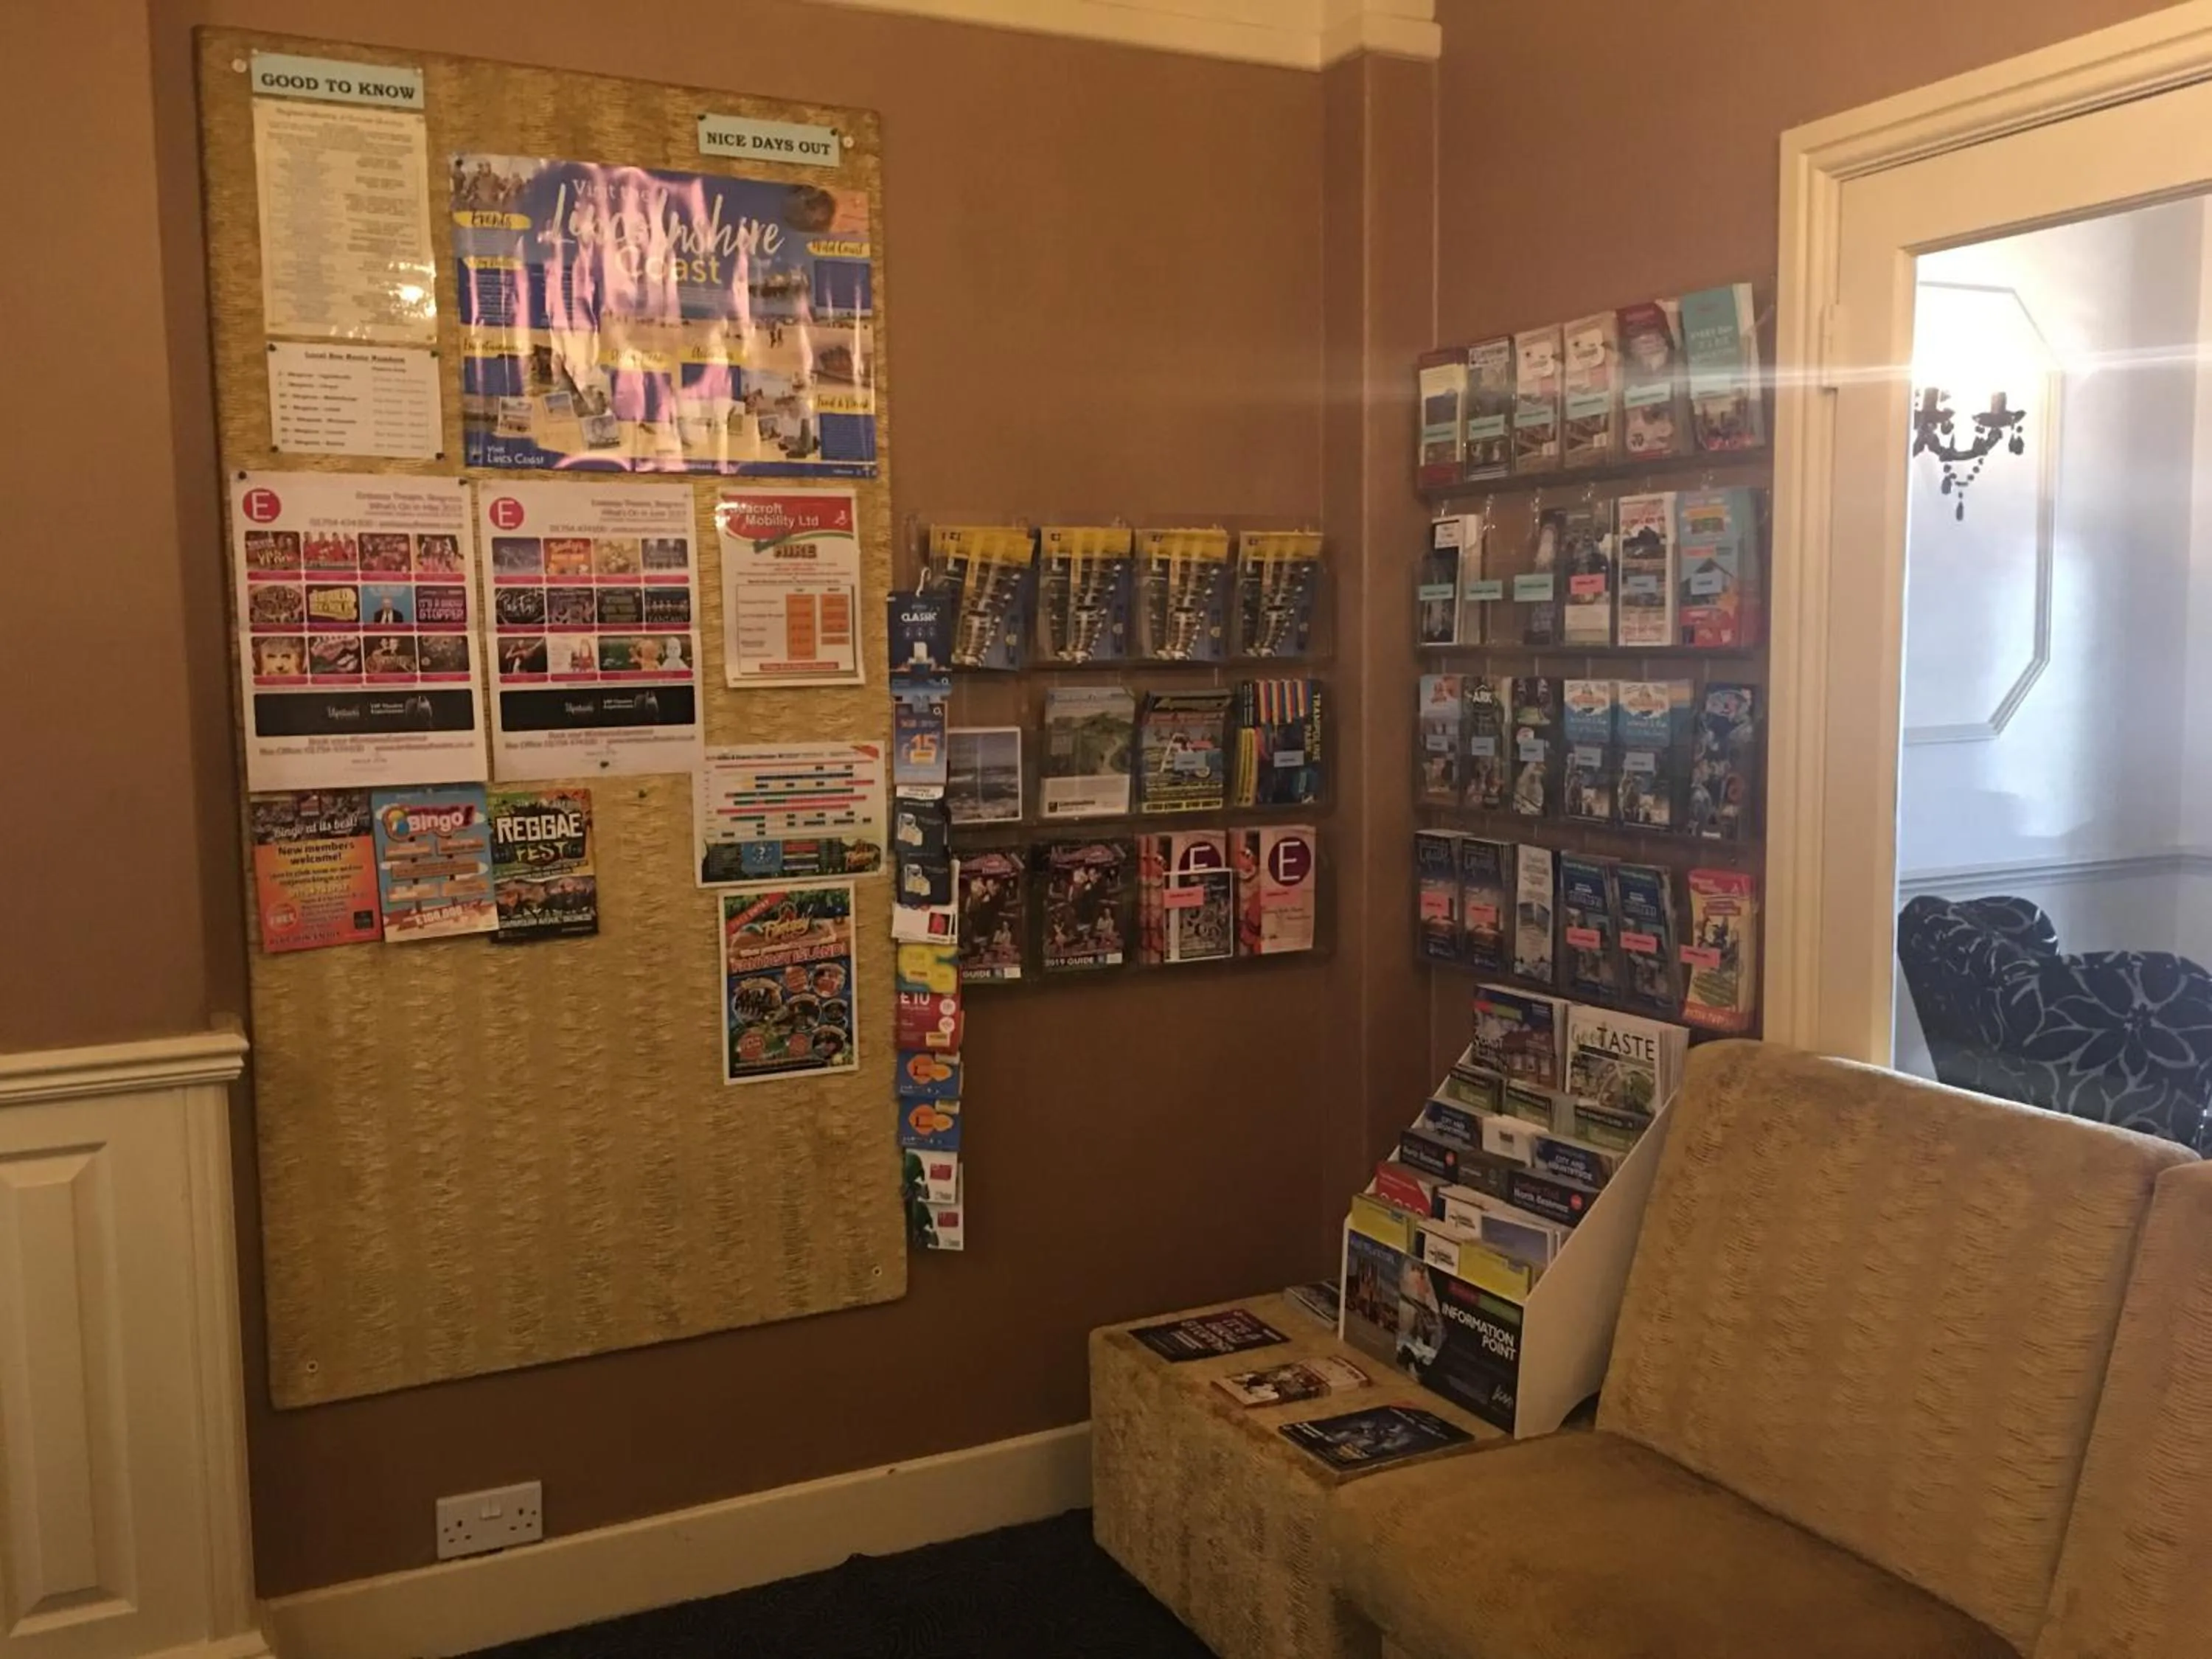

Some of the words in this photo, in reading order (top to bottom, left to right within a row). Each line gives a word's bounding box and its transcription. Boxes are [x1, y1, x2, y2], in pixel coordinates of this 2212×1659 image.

[261, 72, 319, 91] GOOD
[325, 78, 352, 94] TO
[358, 82, 415, 100] KNOW
[706, 131, 748, 148] NICE
[751, 134, 795, 153] DAYS
[798, 138, 832, 156] OUT
[251, 492, 272, 521] E
[497, 501, 516, 527] E
[745, 515, 795, 529] Mobility
[799, 515, 819, 526] Ltd
[497, 813, 583, 844] REGGAE
[516, 841, 569, 861] FEST
[1279, 841, 1301, 881] E
[962, 969, 992, 978] GUIDE
[1596, 1027, 1655, 1061] TASTE
[1441, 1304, 1514, 1347] INFORMATION
[1481, 1336, 1516, 1361] POINT
